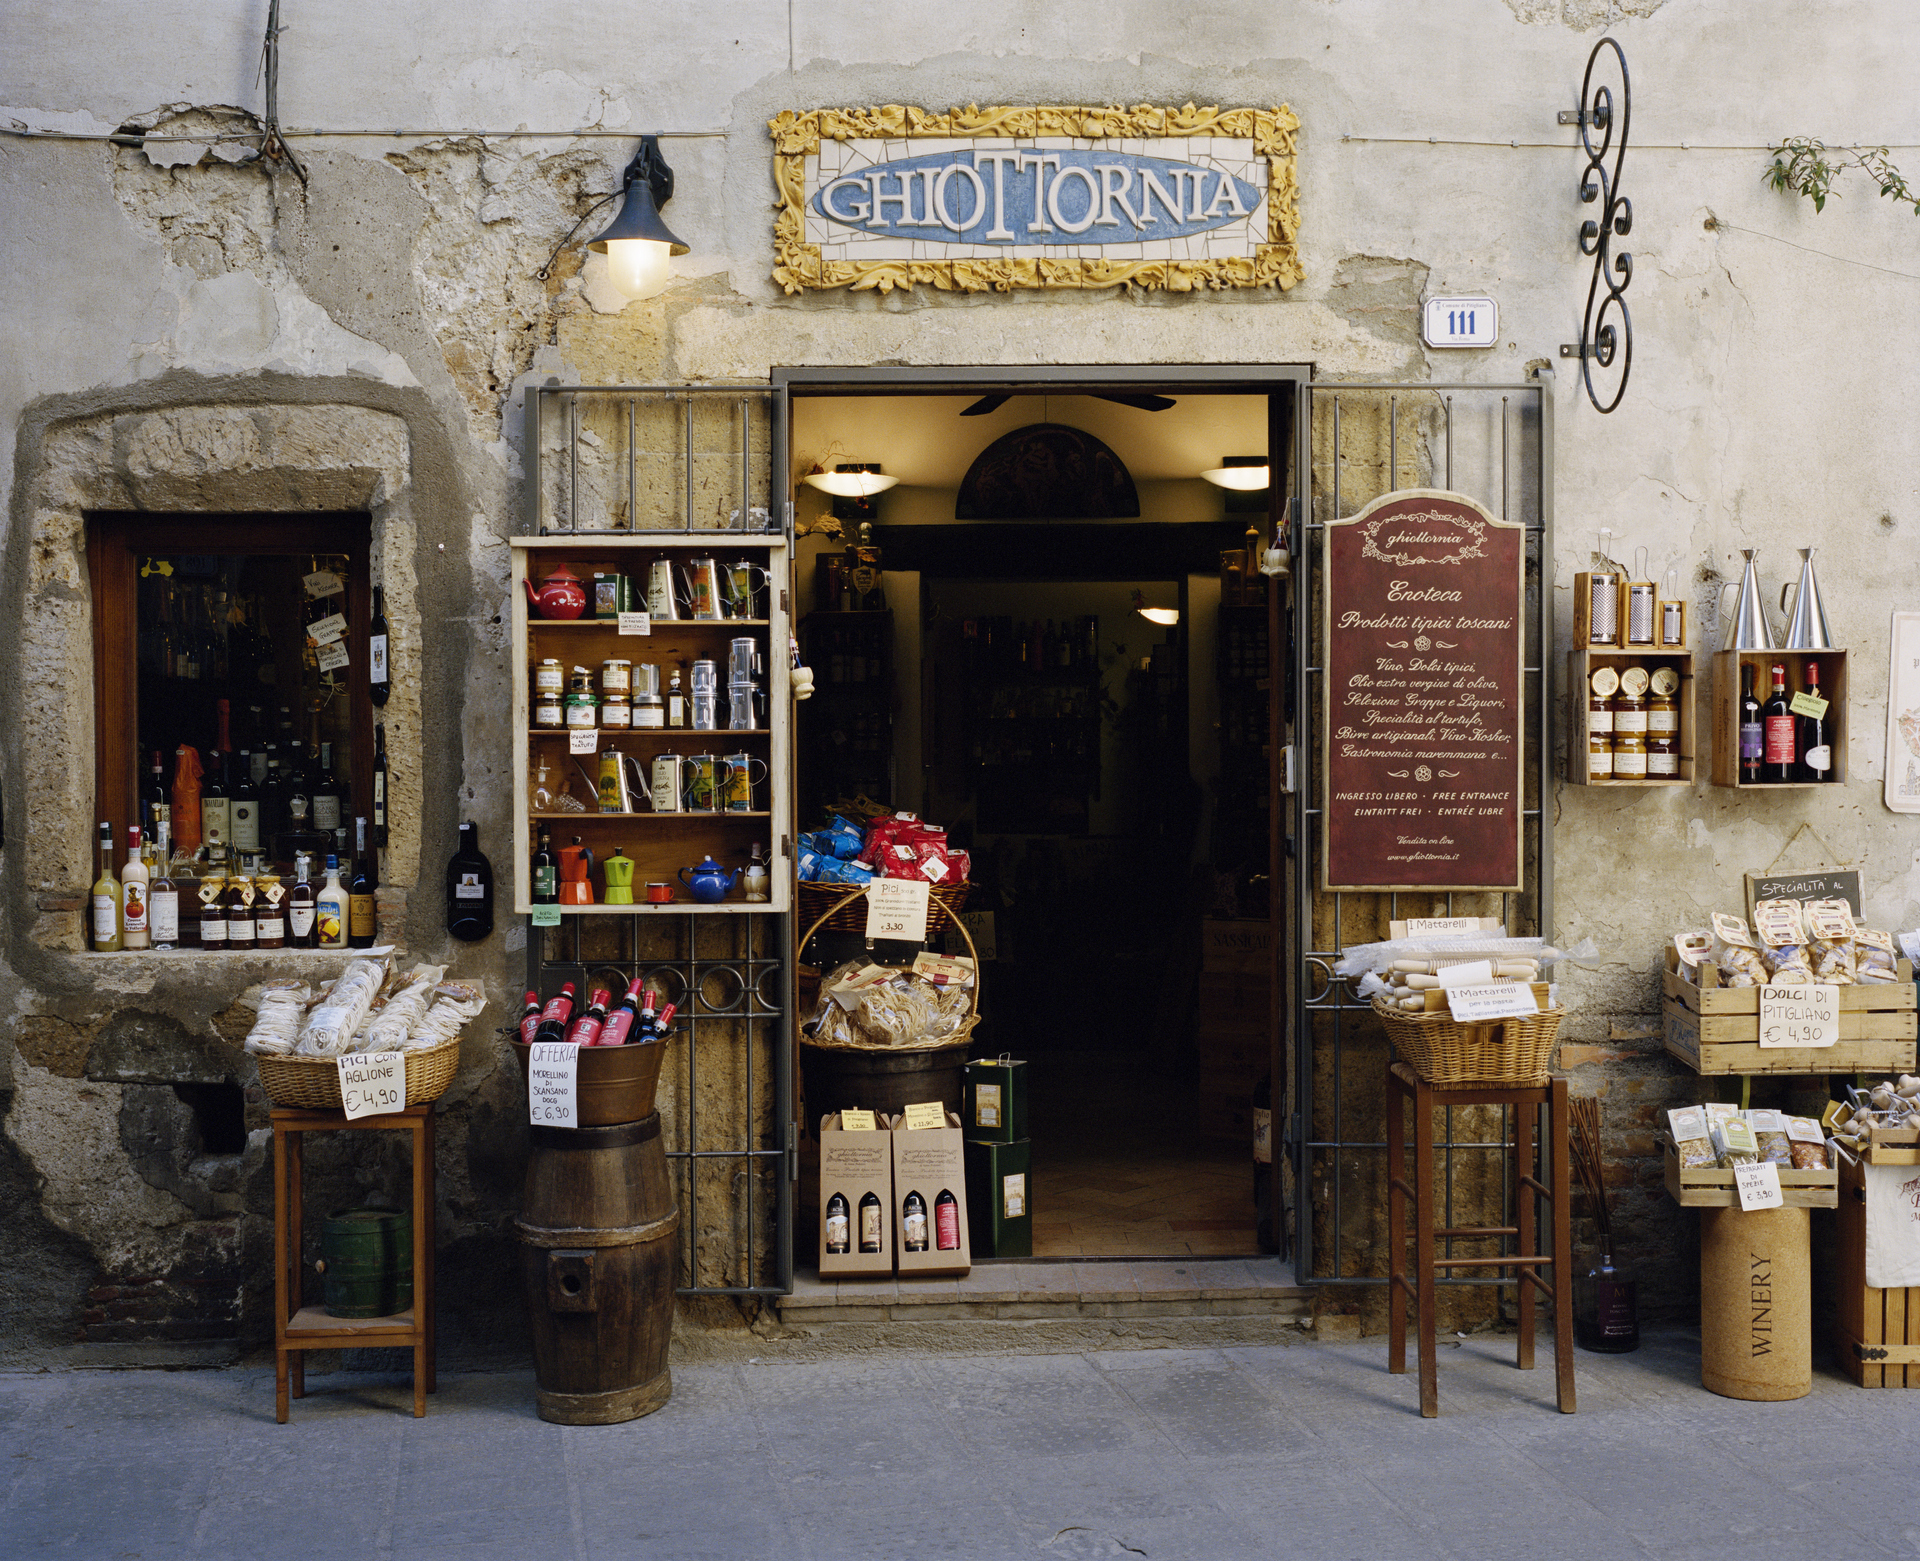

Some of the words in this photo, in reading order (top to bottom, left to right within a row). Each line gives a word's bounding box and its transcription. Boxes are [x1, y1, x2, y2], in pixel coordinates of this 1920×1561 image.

[820, 149, 1251, 241] GHIOTTORNIA
[1448, 311, 1476, 335] 111
[1387, 580, 1463, 601] Enoteca
[1337, 611, 1410, 629] Prodotti
[1411, 616, 1454, 633] tipici
[1455, 616, 1513, 629] toscani
[1376, 657, 1404, 672] Vino,
[1408, 657, 1443, 672] Dolci
[1443, 662, 1476, 675] tipici,
[1348, 674, 1375, 687] Olio
[1376, 677, 1407, 688] extra
[1409, 679, 1450, 692] vergine
[1453, 676, 1465, 688] di
[1467, 675, 1499, 690] oliva,
[1343, 692, 1400, 706] Selezione
[1404, 692, 1446, 710] Grappe
[1448, 699, 1455, 707] e
[1456, 693, 1506, 711] Liquori,
[1362, 709, 1423, 726] Specialità
[1425, 711, 1442, 724] al
[1440, 712, 1483, 728] tartufo,
[1335, 726, 1370, 739] Birre
[1371, 728, 1436, 744] artigianali,
[1439, 728, 1467, 741] Vino
[1468, 728, 1512, 743] Kosher,
[1340, 744, 1413, 758] Gastronomia
[1414, 751, 1487, 759] maremmana
[1335, 792, 1383, 800] INGRESSO
[1385, 792, 1418, 800] LIBERO
[1432, 792, 1457, 800] FREE
[1460, 791, 1510, 800] ENTRANCE
[1354, 808, 1397, 817] EINTRITT
[1399, 808, 1422, 816] FREI
[1437, 805, 1475, 816] ENTRÉE
[1478, 807, 1505, 816] LIBRE
[1397, 836, 1427, 845] Vendita
[1438, 836, 1455, 845] line
[1387, 851, 1460, 863] www.ghiottornia.it
[881, 883, 899, 893] Pici
[1833, 881, 1843, 889] AL
[885, 922, 904, 931] 3,30
[1409, 920, 1413, 930] I
[1416, 919, 1467, 930] Mattarelli
[1451, 991, 1457, 999] I
[1460, 986, 1517, 998] Mattarelli
[1763, 988, 1807, 1001] DOLCI
[1815, 990, 1827, 1003] DI
[1763, 1004, 1831, 1021] PITIGLIANO
[1763, 1025, 1781, 1043] €
[1788, 1026, 1822, 1043] 4,90
[340, 1055, 368, 1069] PICI
[374, 1053, 397, 1063] CON
[532, 1044, 577, 1063] OFFERTA
[345, 1067, 394, 1085] AGLIONE
[532, 1069, 569, 1079] MORELLINO
[532, 1086, 569, 1096] SCANSANO
[344, 1090, 361, 1112] €
[363, 1088, 398, 1108] 4,90
[531, 1106, 542, 1120] €
[544, 1106, 570, 1120] 6,90
[1735, 1164, 1766, 1174] PREPARATI
[1741, 1180, 1765, 1189] SPEZIE
[1746, 1193, 1753, 1201] €
[1755, 1190, 1774, 1200] 3,90
[1751, 1252, 1772, 1359] WINERY
